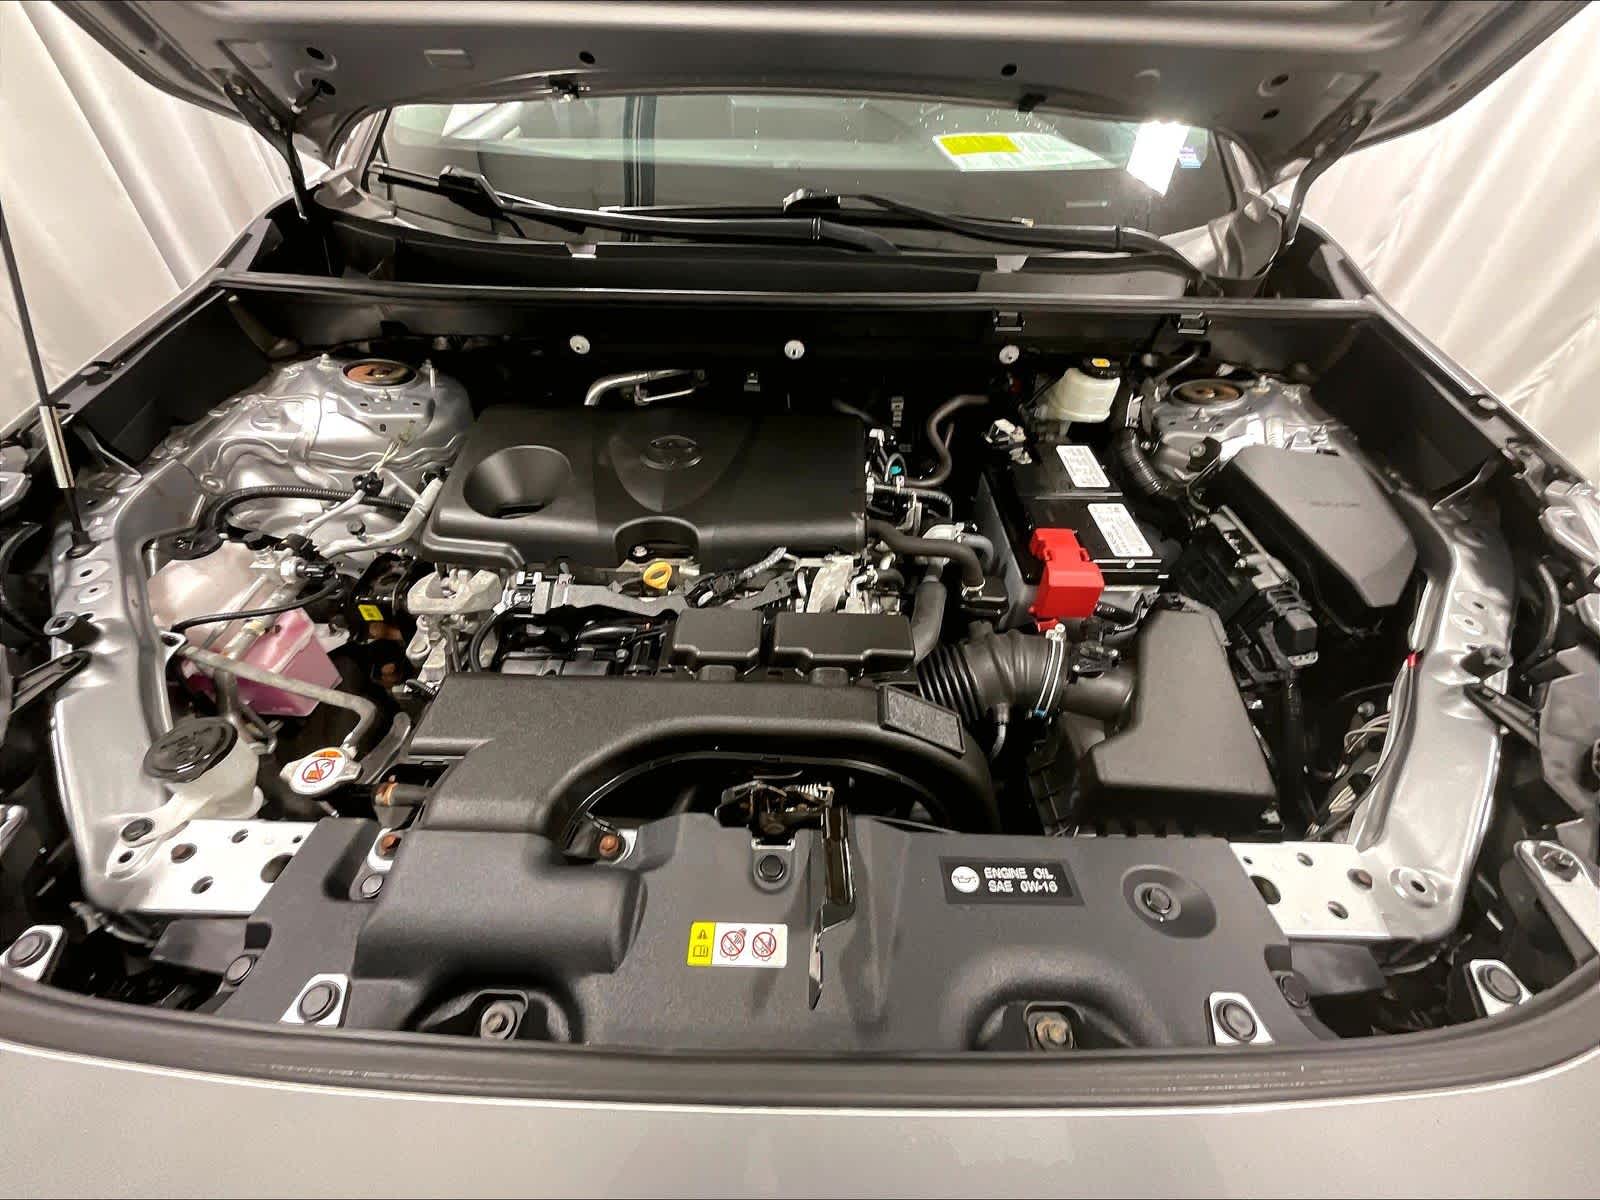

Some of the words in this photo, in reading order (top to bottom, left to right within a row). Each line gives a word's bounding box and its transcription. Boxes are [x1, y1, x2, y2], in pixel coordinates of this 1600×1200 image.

[984, 867, 1028, 879] ENGINE
[1033, 867, 1054, 879] OIL
[988, 880, 1014, 893] SAE
[1020, 880, 1058, 893] 0W-16
